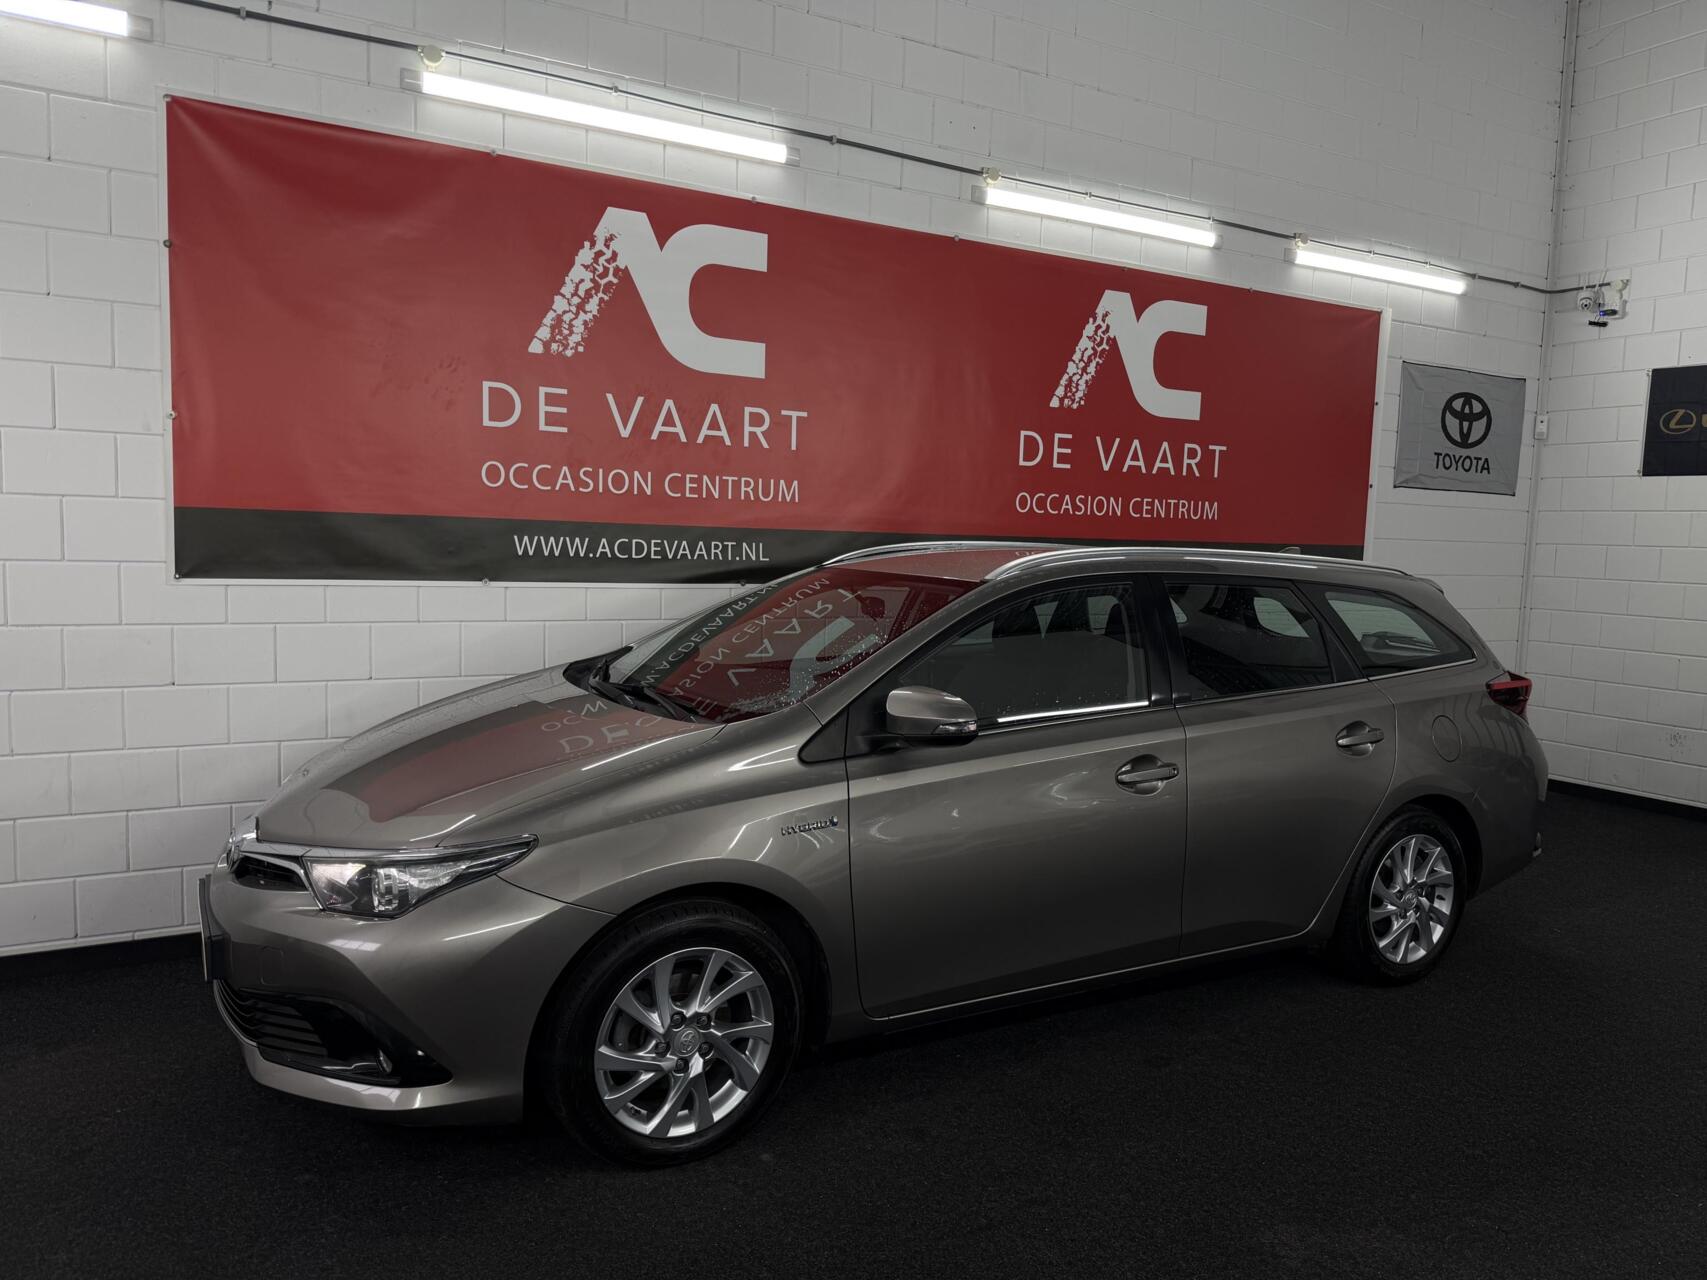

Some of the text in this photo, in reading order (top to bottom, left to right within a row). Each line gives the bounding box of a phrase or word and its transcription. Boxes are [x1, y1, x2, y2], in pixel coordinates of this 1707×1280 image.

[482, 380, 808, 451] DE VAART
[1018, 430, 1227, 478] DE VAART
[1434, 452, 1491, 475] TOYOTA
[481, 460, 799, 503] OCCASION CENTRUM
[1015, 491, 1219, 521] OCCASION CENTRUM
[513, 535, 770, 561] WWW.ACDEVAART.NL
